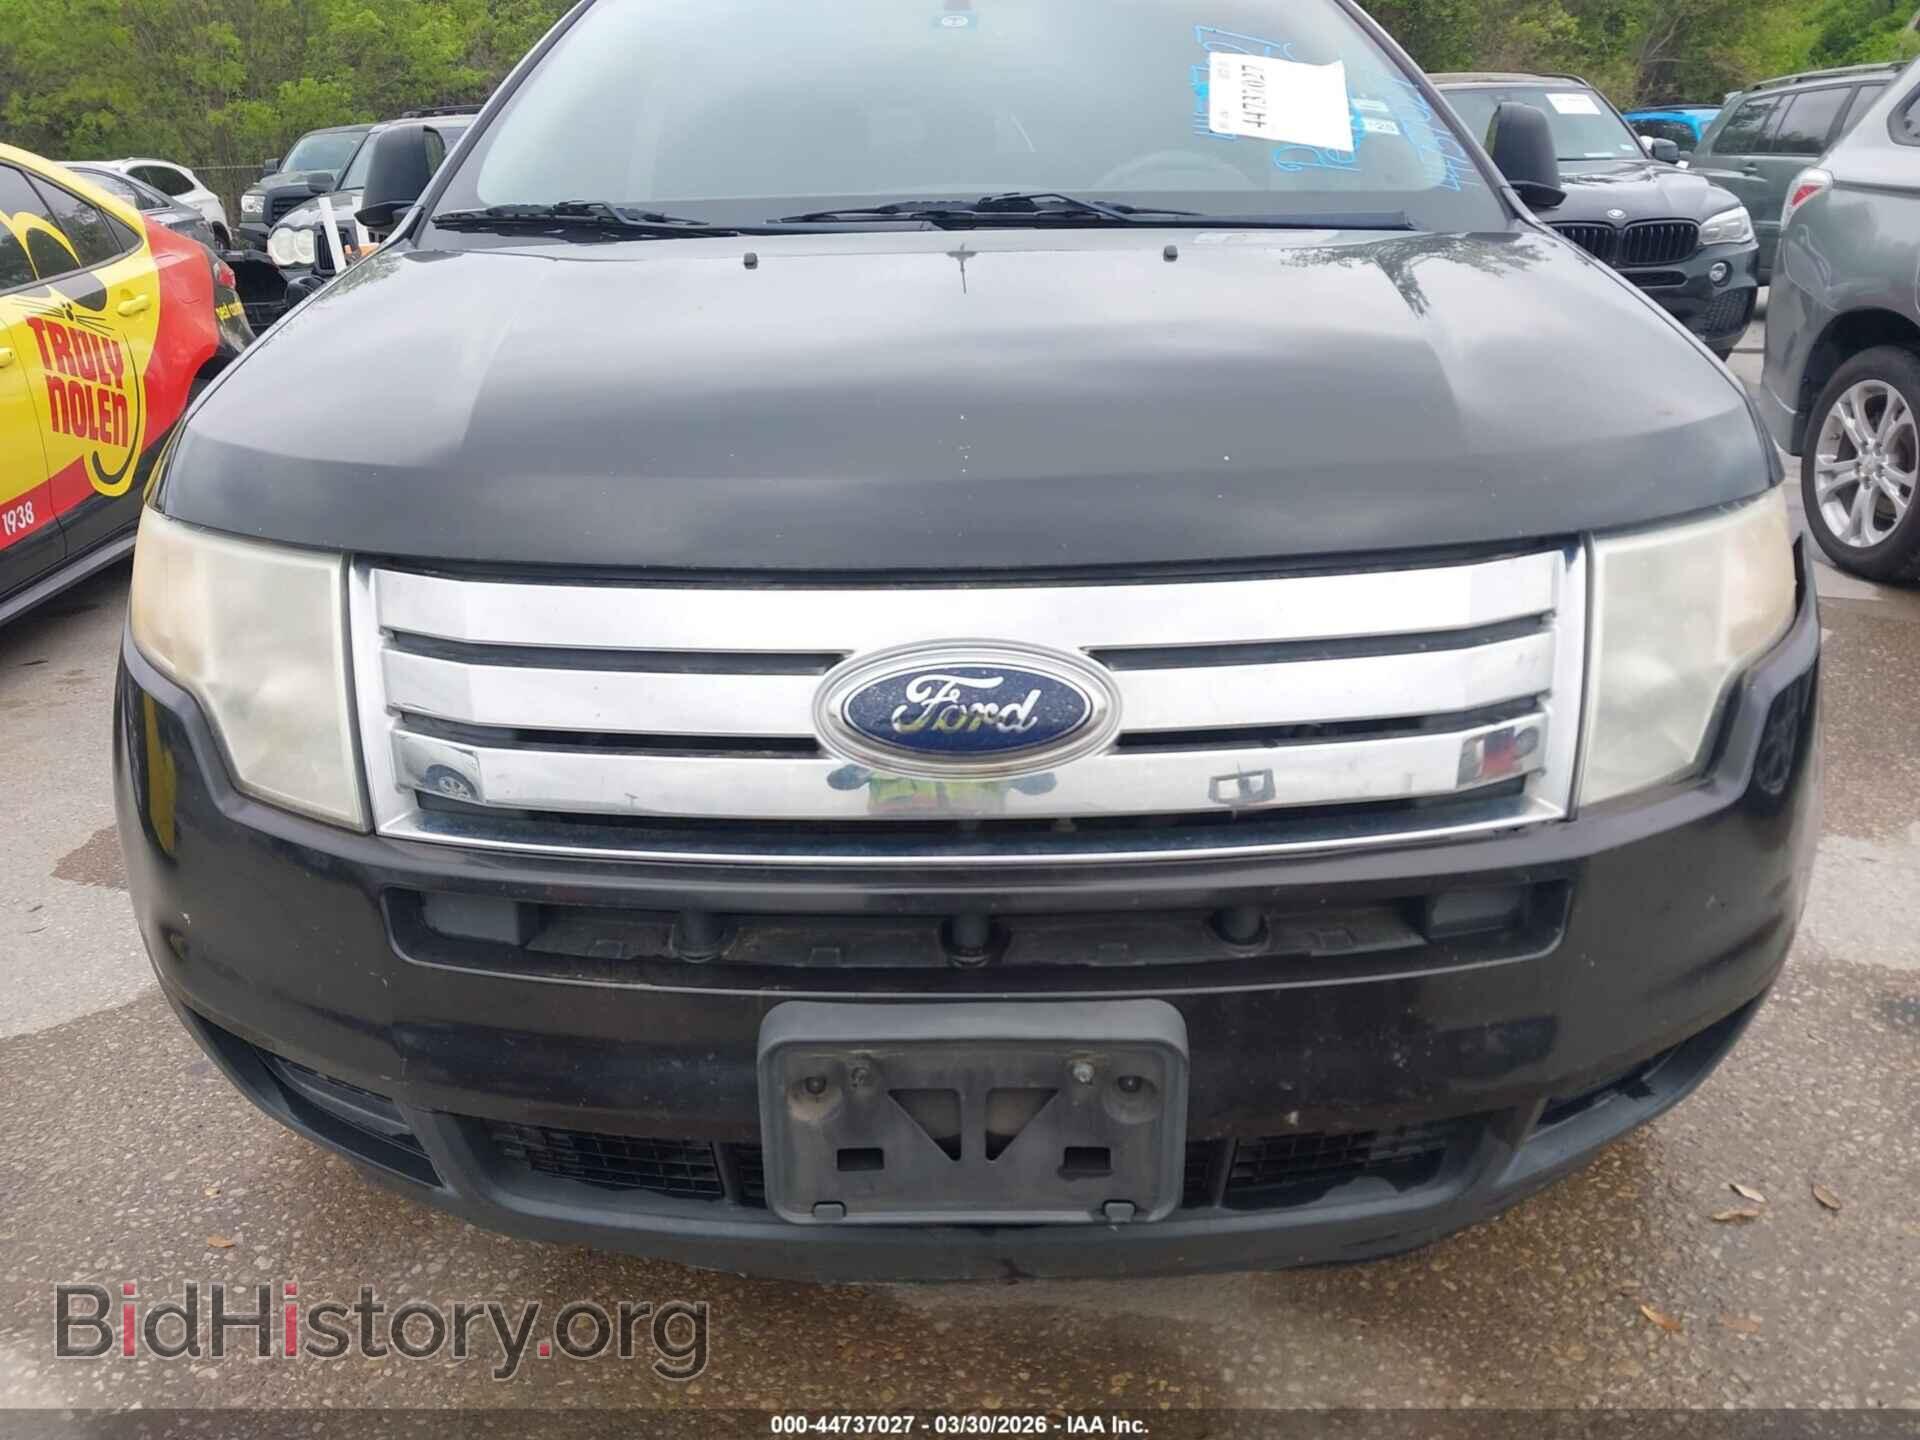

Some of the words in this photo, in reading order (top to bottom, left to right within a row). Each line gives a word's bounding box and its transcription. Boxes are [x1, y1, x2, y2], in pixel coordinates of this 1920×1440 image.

[26, 316, 124, 389] TRULY
[45, 374, 128, 447] NOLEN
[2, 501, 34, 535] 1938
[892, 675, 1042, 734] Ford
